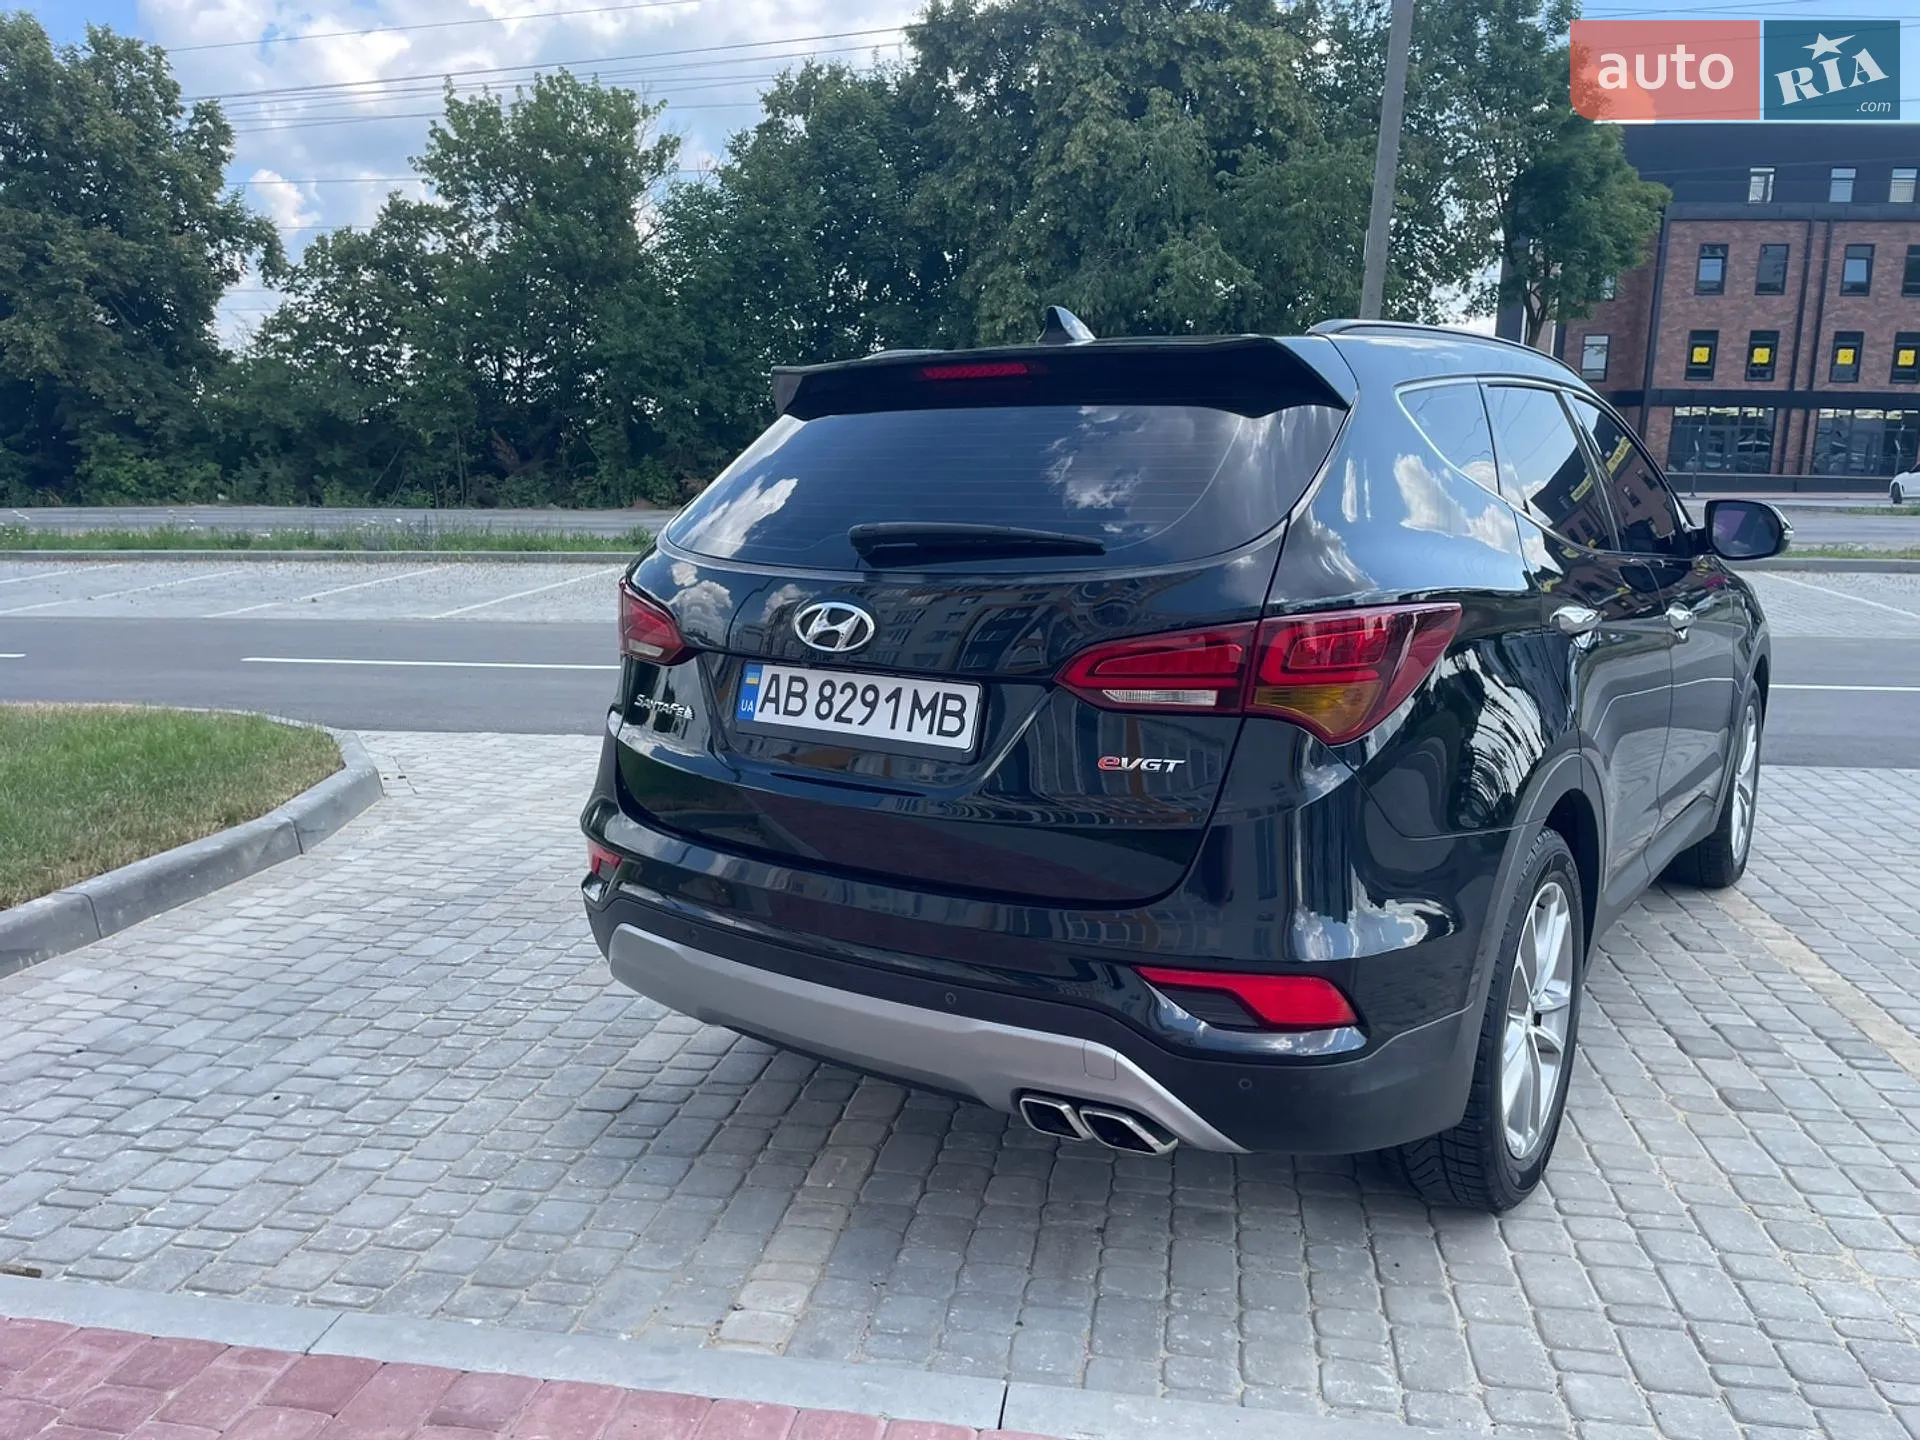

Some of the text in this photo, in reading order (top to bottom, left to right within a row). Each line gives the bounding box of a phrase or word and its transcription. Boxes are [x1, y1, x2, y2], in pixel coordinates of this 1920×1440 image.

[741, 699, 754, 712] UA
[759, 674, 967, 738] AB 8291 MB
[1097, 756, 1186, 773] eVGT
